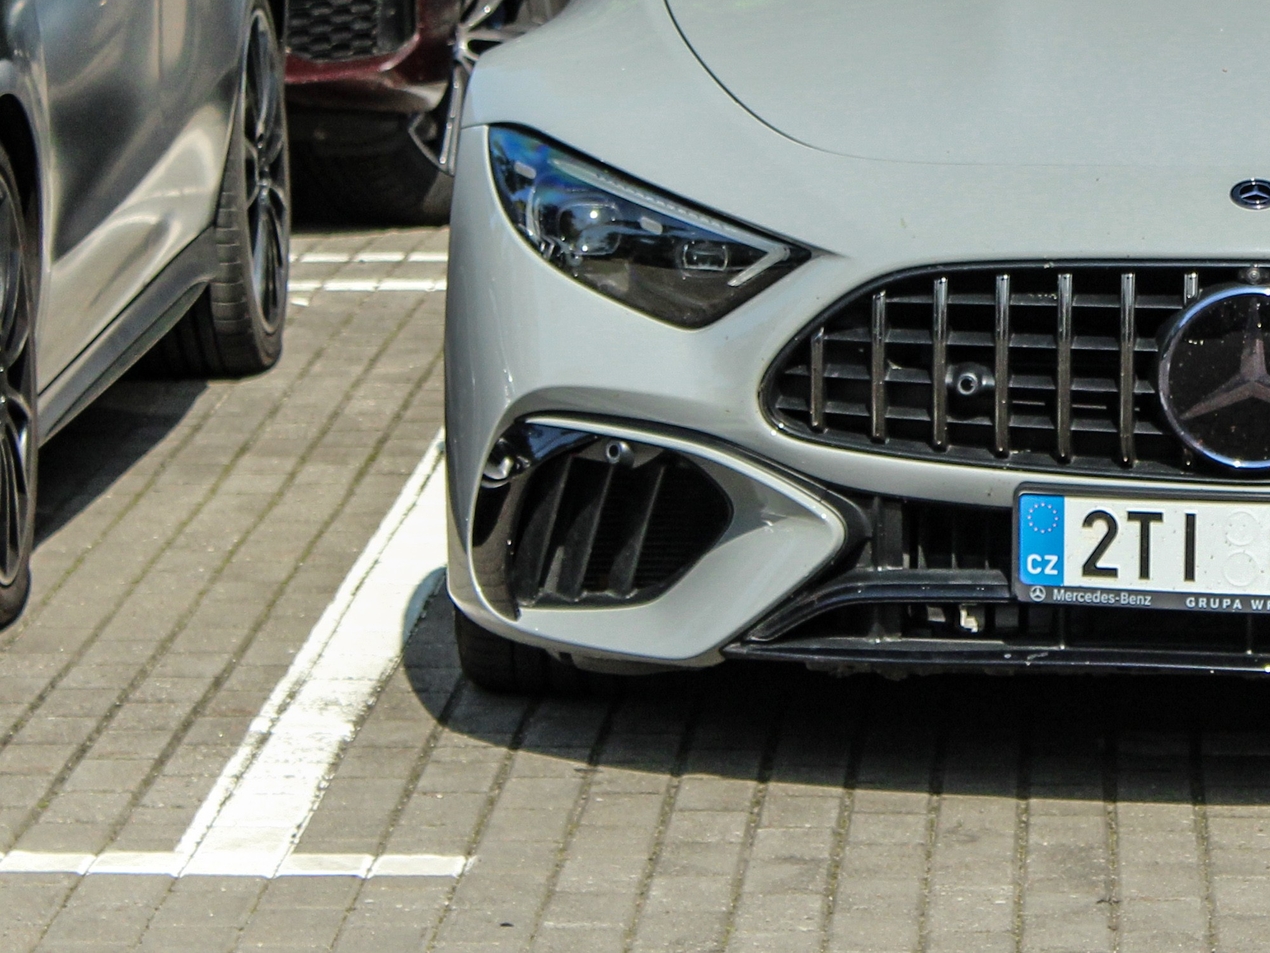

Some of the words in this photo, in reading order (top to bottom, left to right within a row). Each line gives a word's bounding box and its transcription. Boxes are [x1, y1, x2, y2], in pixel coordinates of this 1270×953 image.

[1081, 509, 1197, 582] 2TI
[1026, 555, 1059, 575] CZ
[1052, 588, 1152, 607] Mercedes-Benz
[1185, 596, 1243, 611] GRUPA
